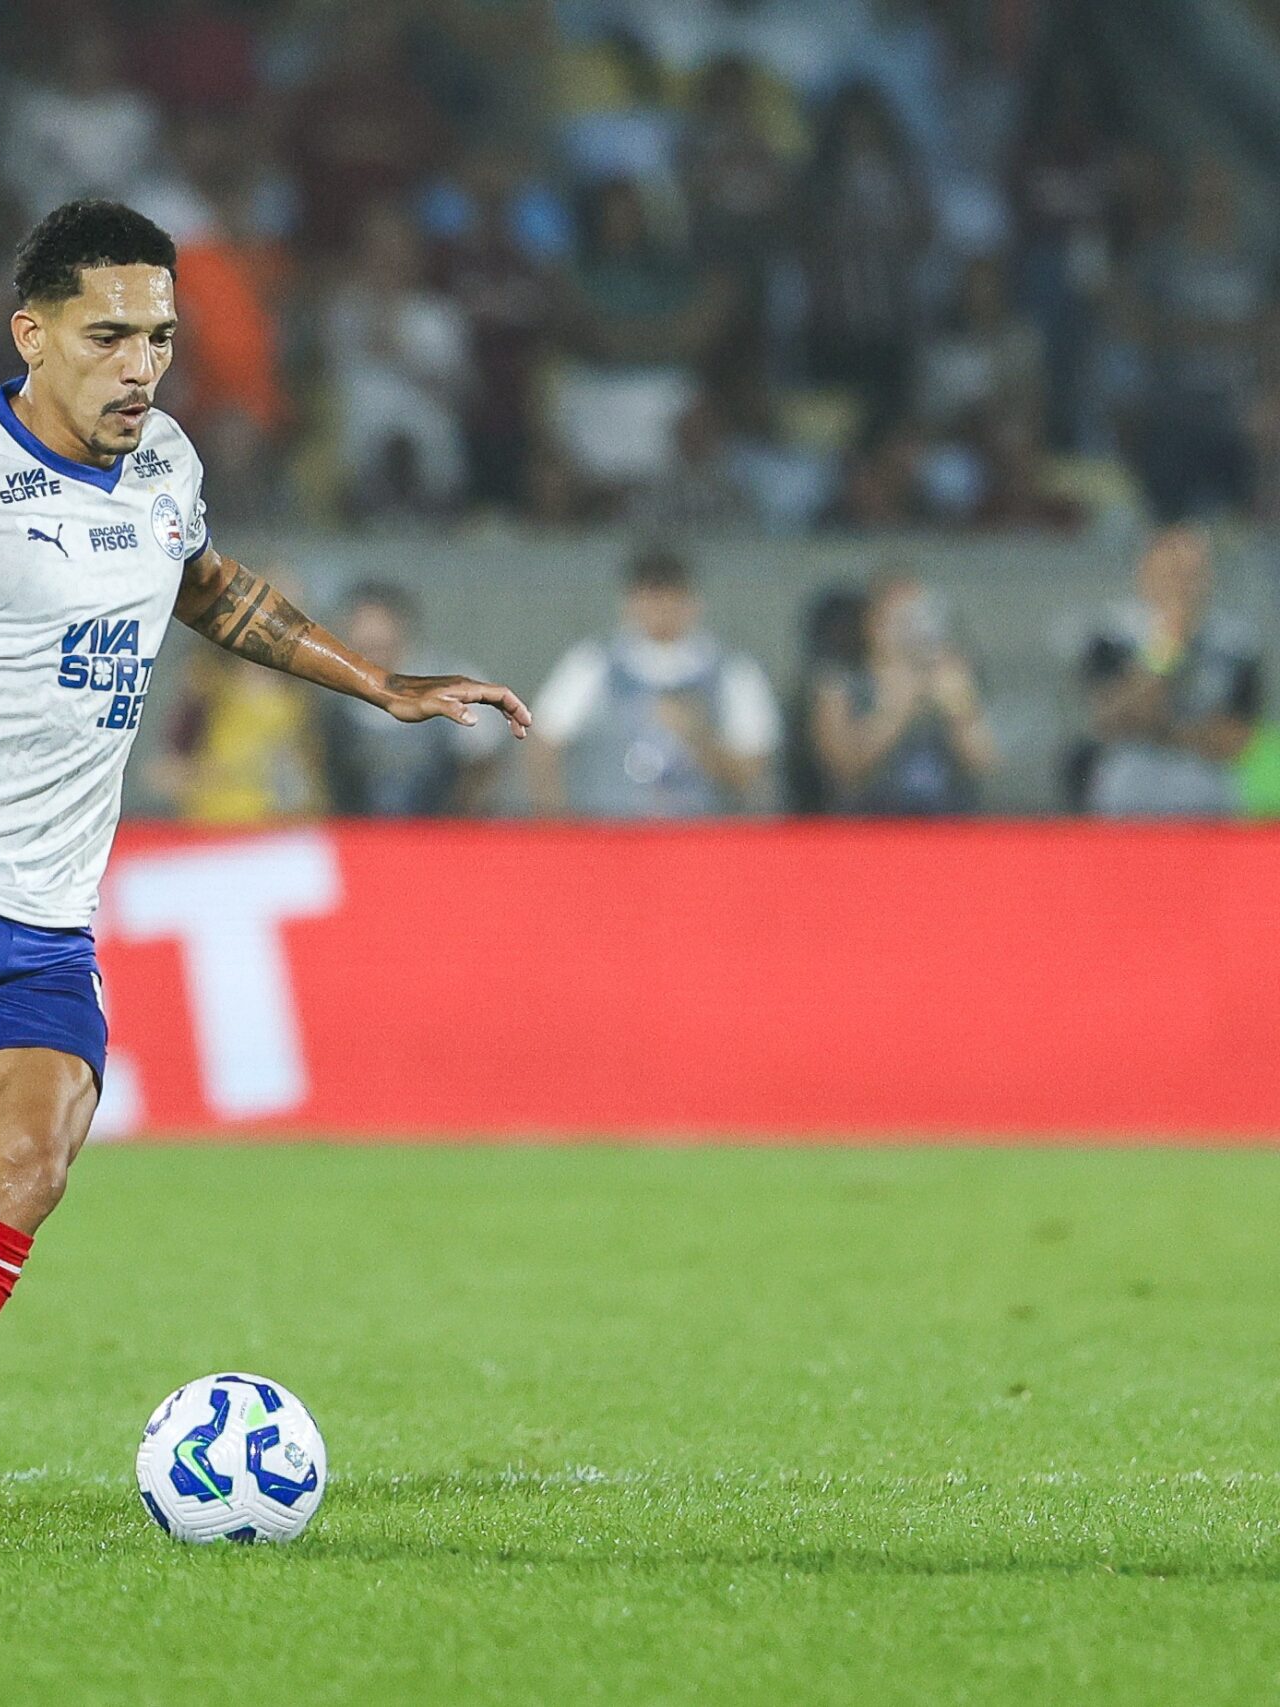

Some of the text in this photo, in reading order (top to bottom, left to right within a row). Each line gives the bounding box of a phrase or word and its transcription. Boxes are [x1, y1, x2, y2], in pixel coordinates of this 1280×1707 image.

[131, 448, 160, 465] VIVA
[5, 467, 46, 489] VIVA
[133, 460, 174, 479] SORTE
[0, 480, 62, 504] SORTE
[90, 533, 138, 552] PISOS
[61, 619, 140, 656] VIVA
